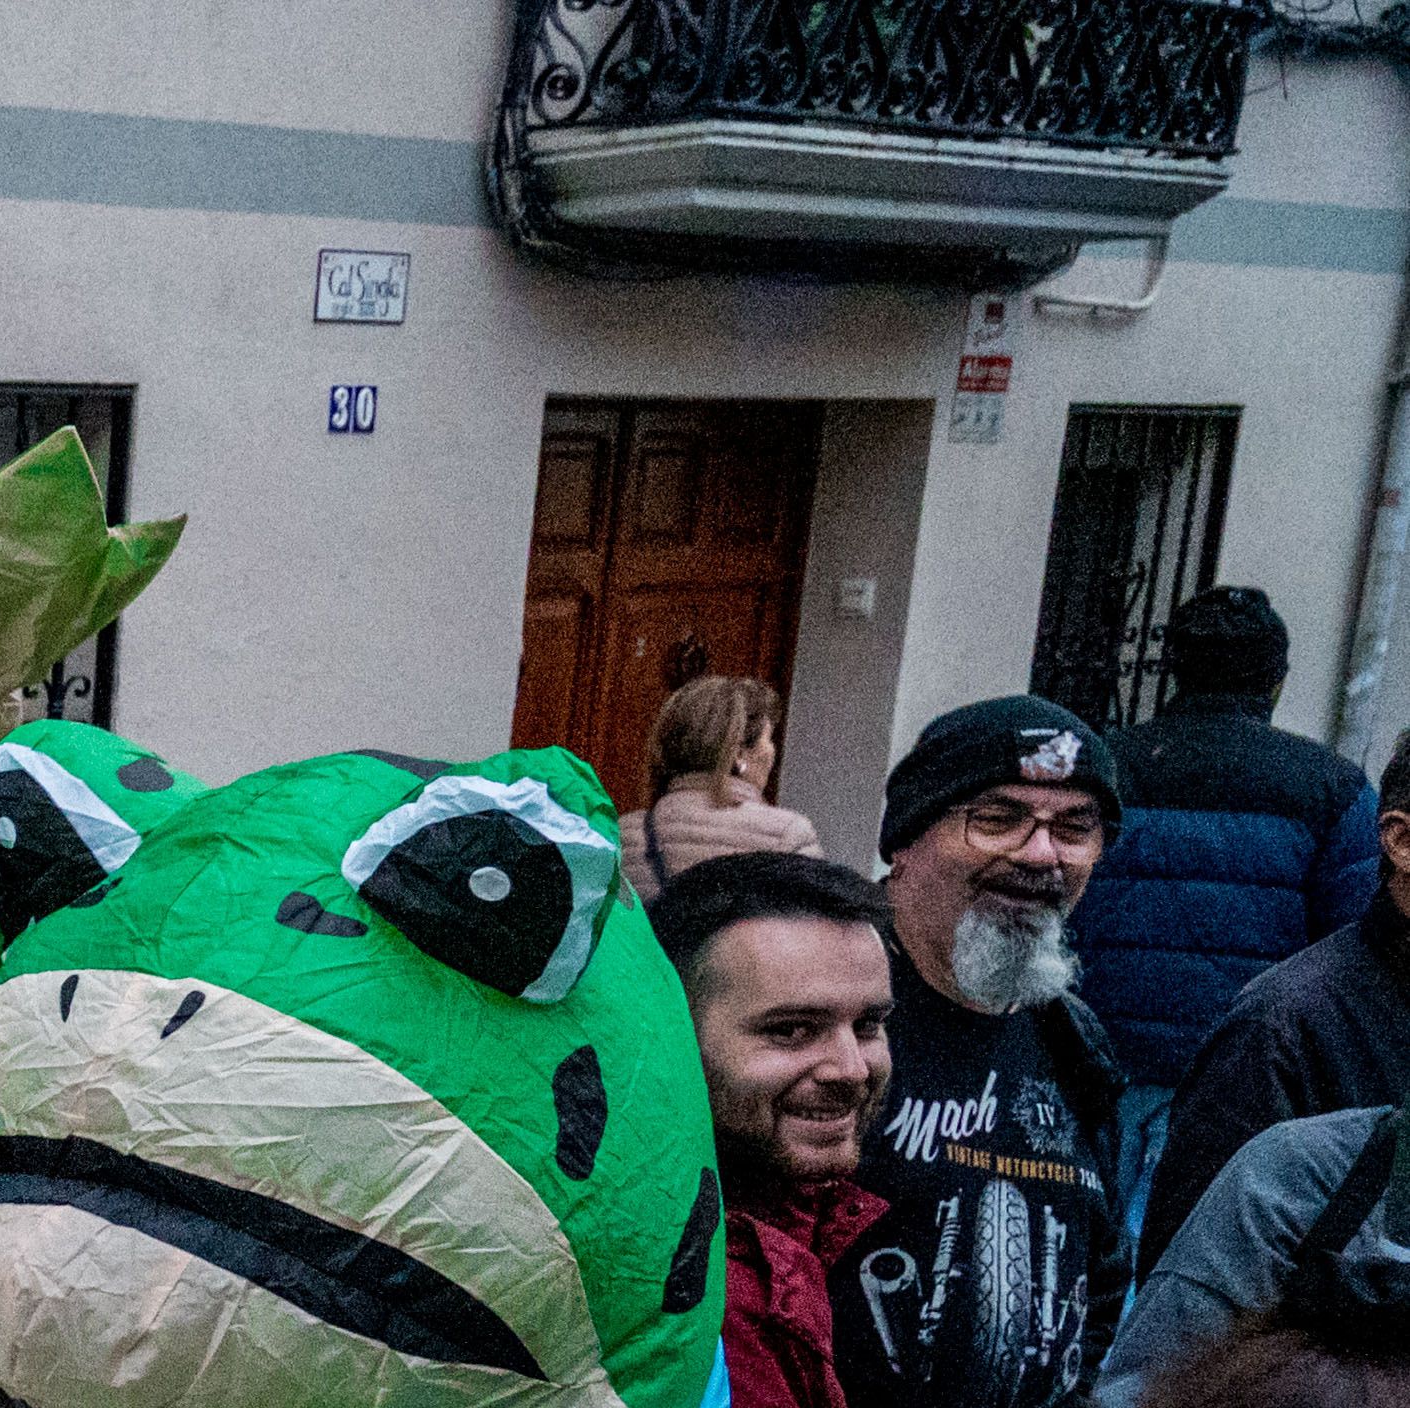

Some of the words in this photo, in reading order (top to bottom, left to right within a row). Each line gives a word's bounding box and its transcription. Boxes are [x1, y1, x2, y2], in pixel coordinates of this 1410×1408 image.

[328, 265, 354, 297] Cal
[331, 386, 376, 429] 30
[883, 1070, 998, 1162] Mach
[1035, 1102, 1056, 1127] IV
[945, 1143, 992, 1171] VINTAGE
[995, 1154, 1076, 1185] MOTORCYCLE
